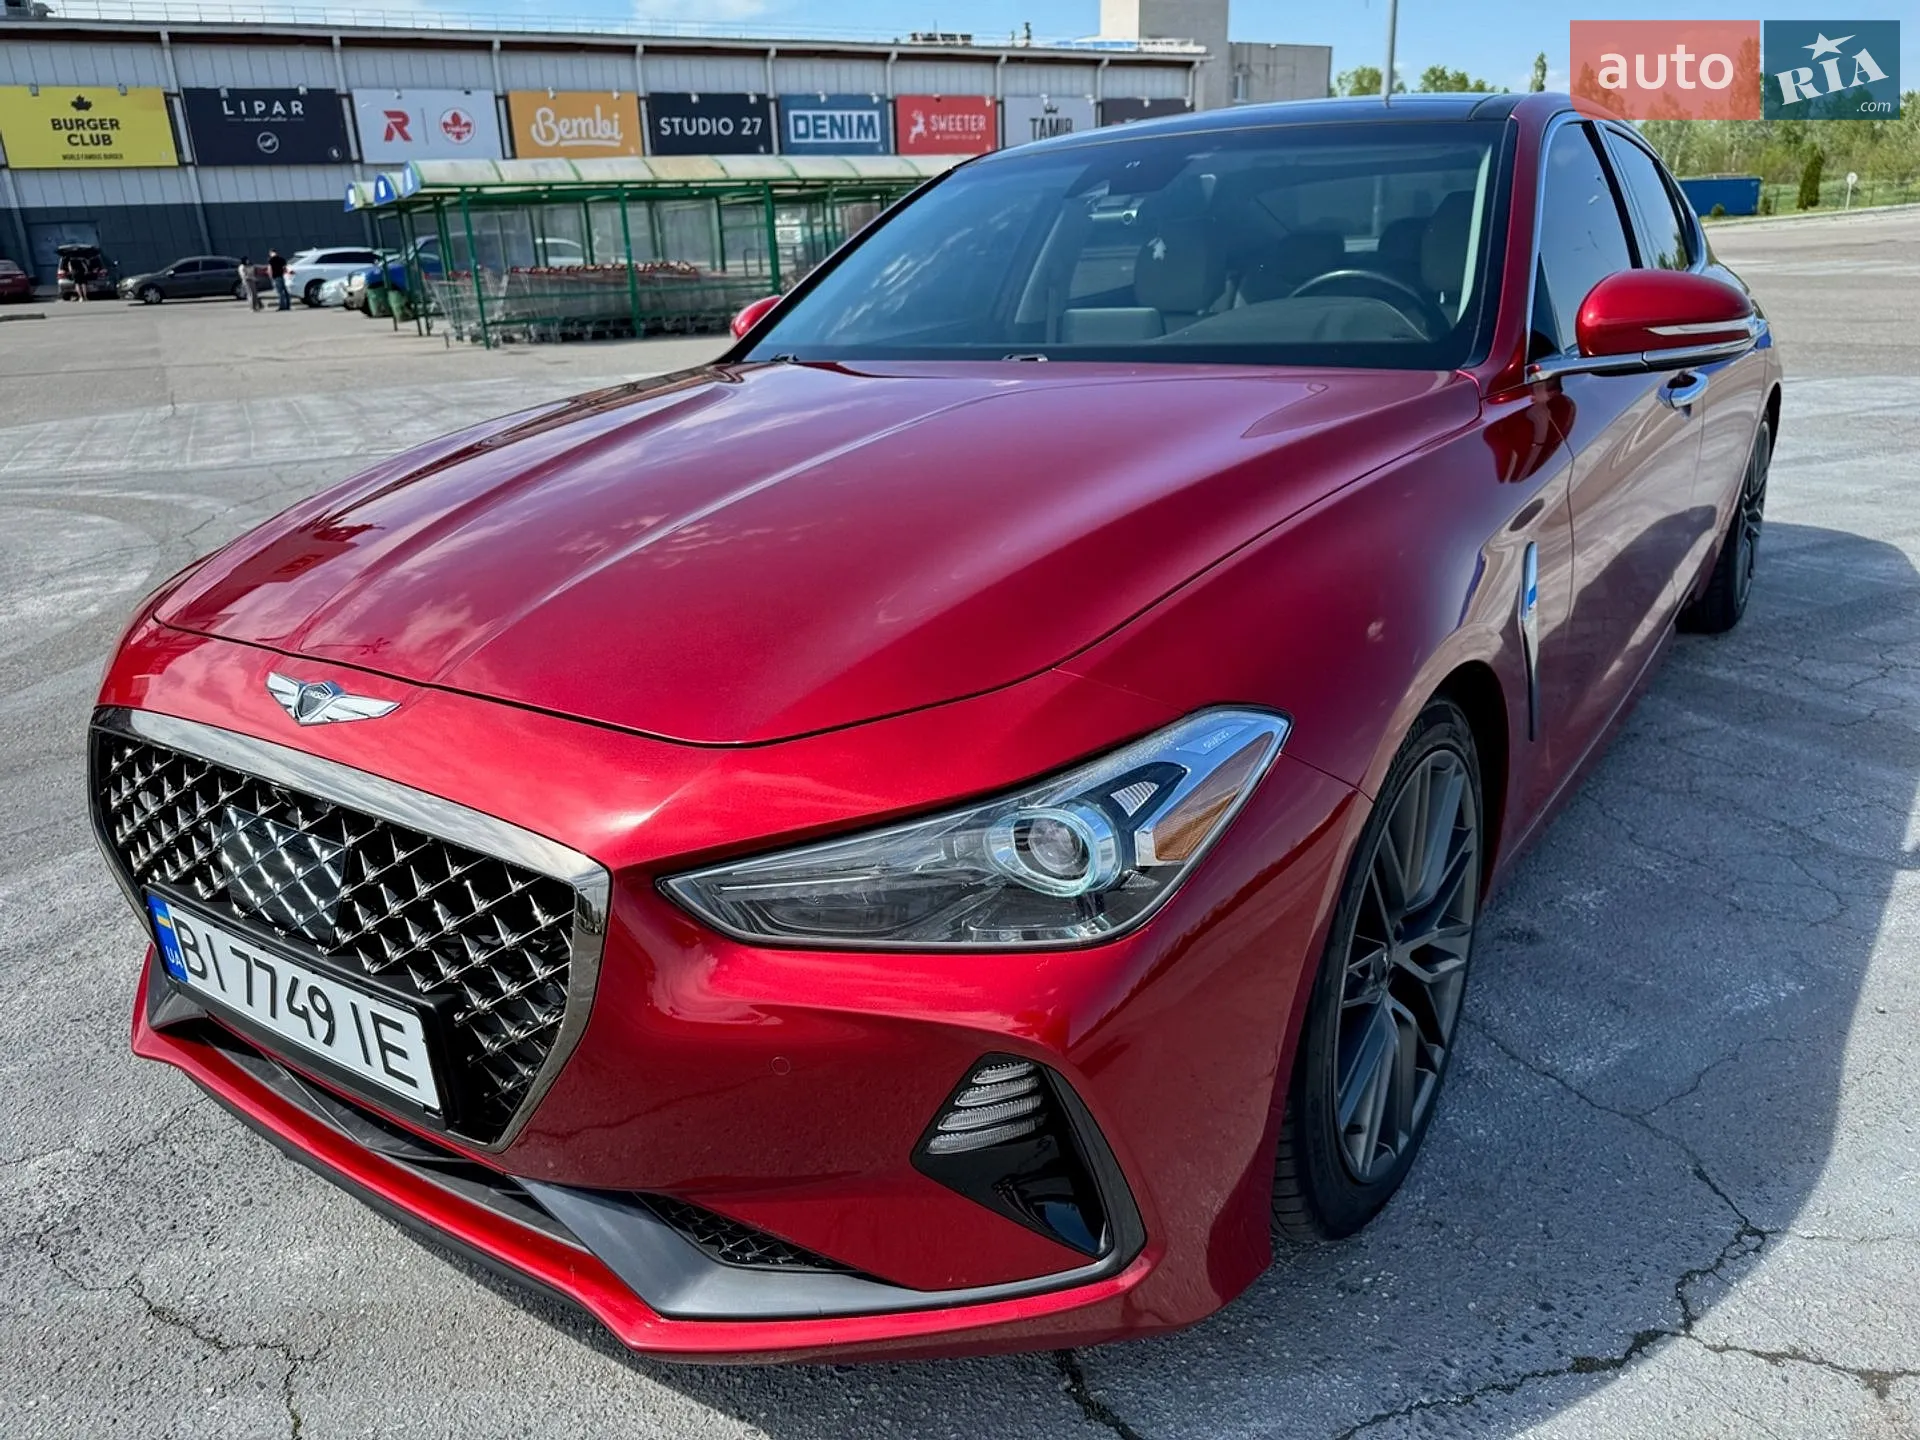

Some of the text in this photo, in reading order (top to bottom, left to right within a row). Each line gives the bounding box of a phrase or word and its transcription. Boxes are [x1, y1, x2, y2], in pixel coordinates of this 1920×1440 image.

[222, 100, 304, 115] LIPAR
[51, 118, 120, 131] BURGER
[531, 104, 624, 147] Bembi
[659, 117, 762, 136] STUDIO 27
[792, 114, 878, 141] DENIM
[930, 114, 986, 132] SWEETER
[67, 134, 113, 146] CLUB
[166, 946, 183, 969] UA
[230, 945, 336, 1047] 7749
[350, 1001, 419, 1089] IE
